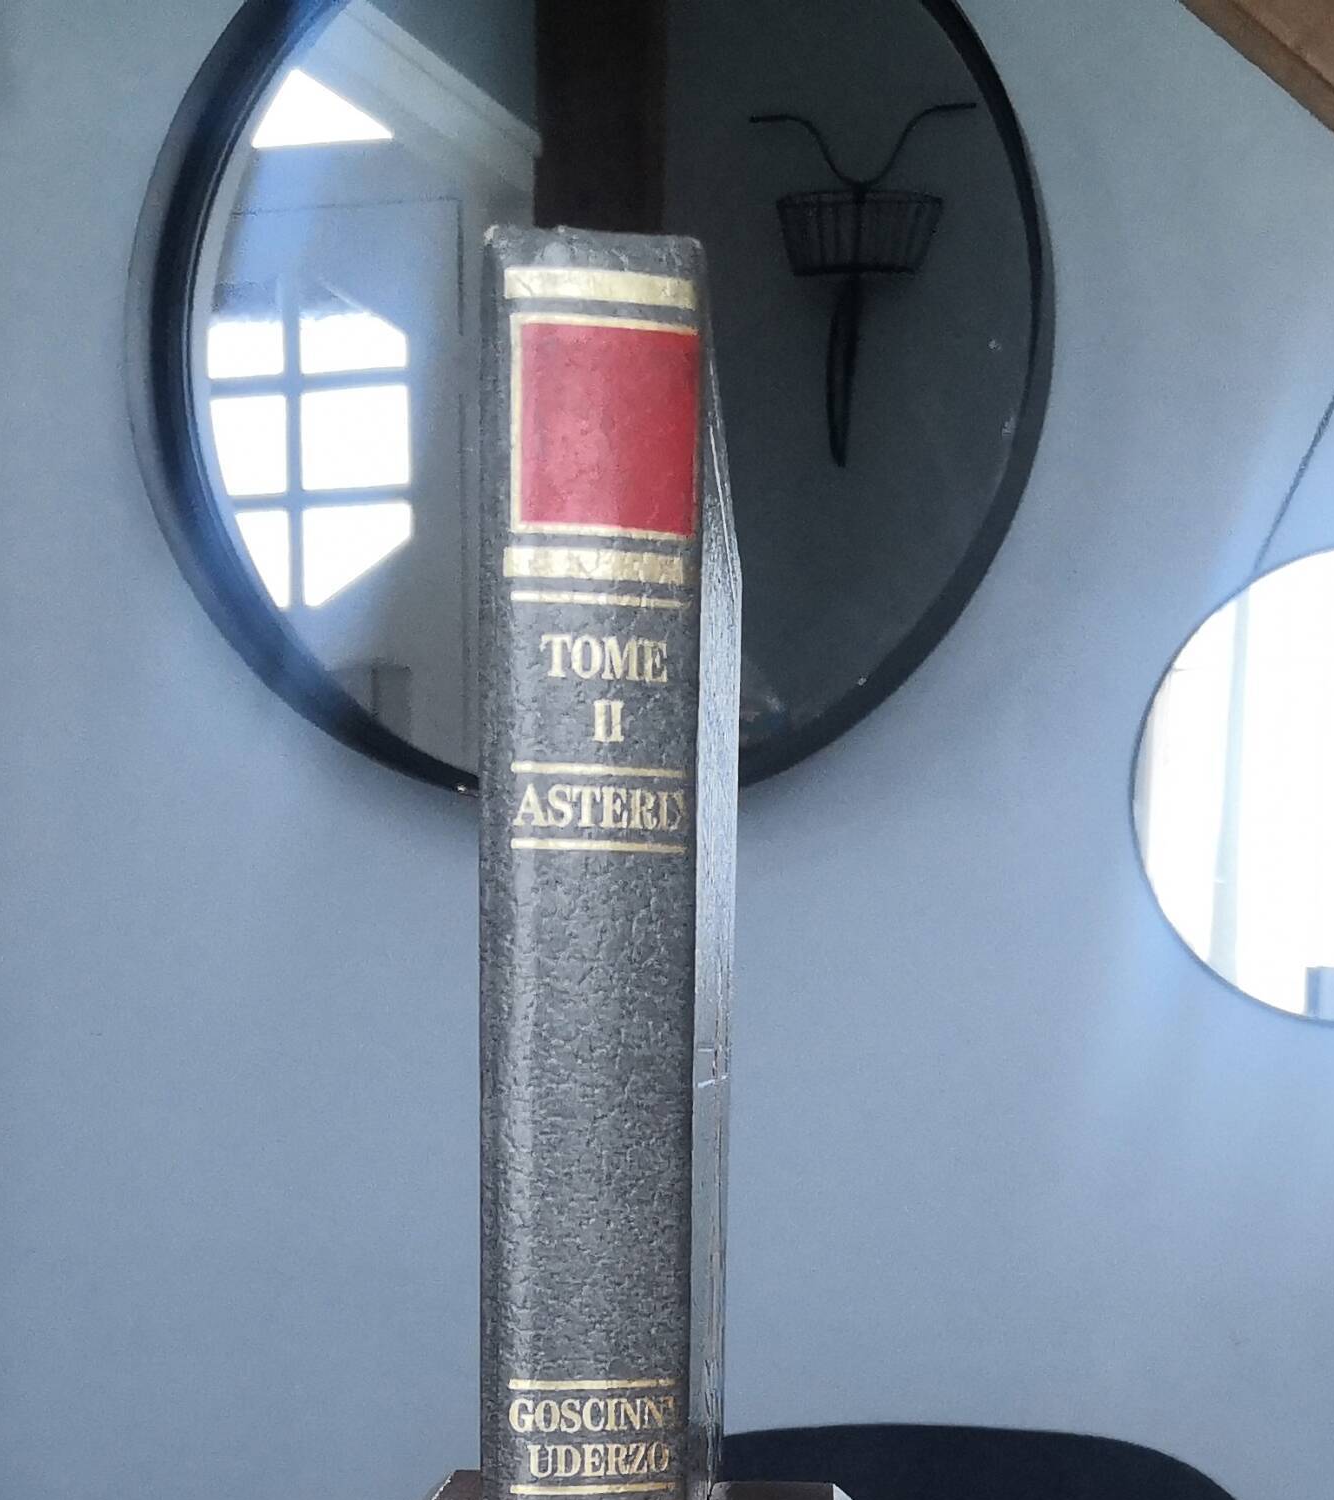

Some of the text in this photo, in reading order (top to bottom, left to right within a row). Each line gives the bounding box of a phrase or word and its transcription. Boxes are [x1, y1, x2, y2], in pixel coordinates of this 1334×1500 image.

[540, 632, 669, 684] TOME
[591, 698, 625, 743] II
[508, 1395, 676, 1434] GOSCINN
[526, 1440, 670, 1479] UDERZO
